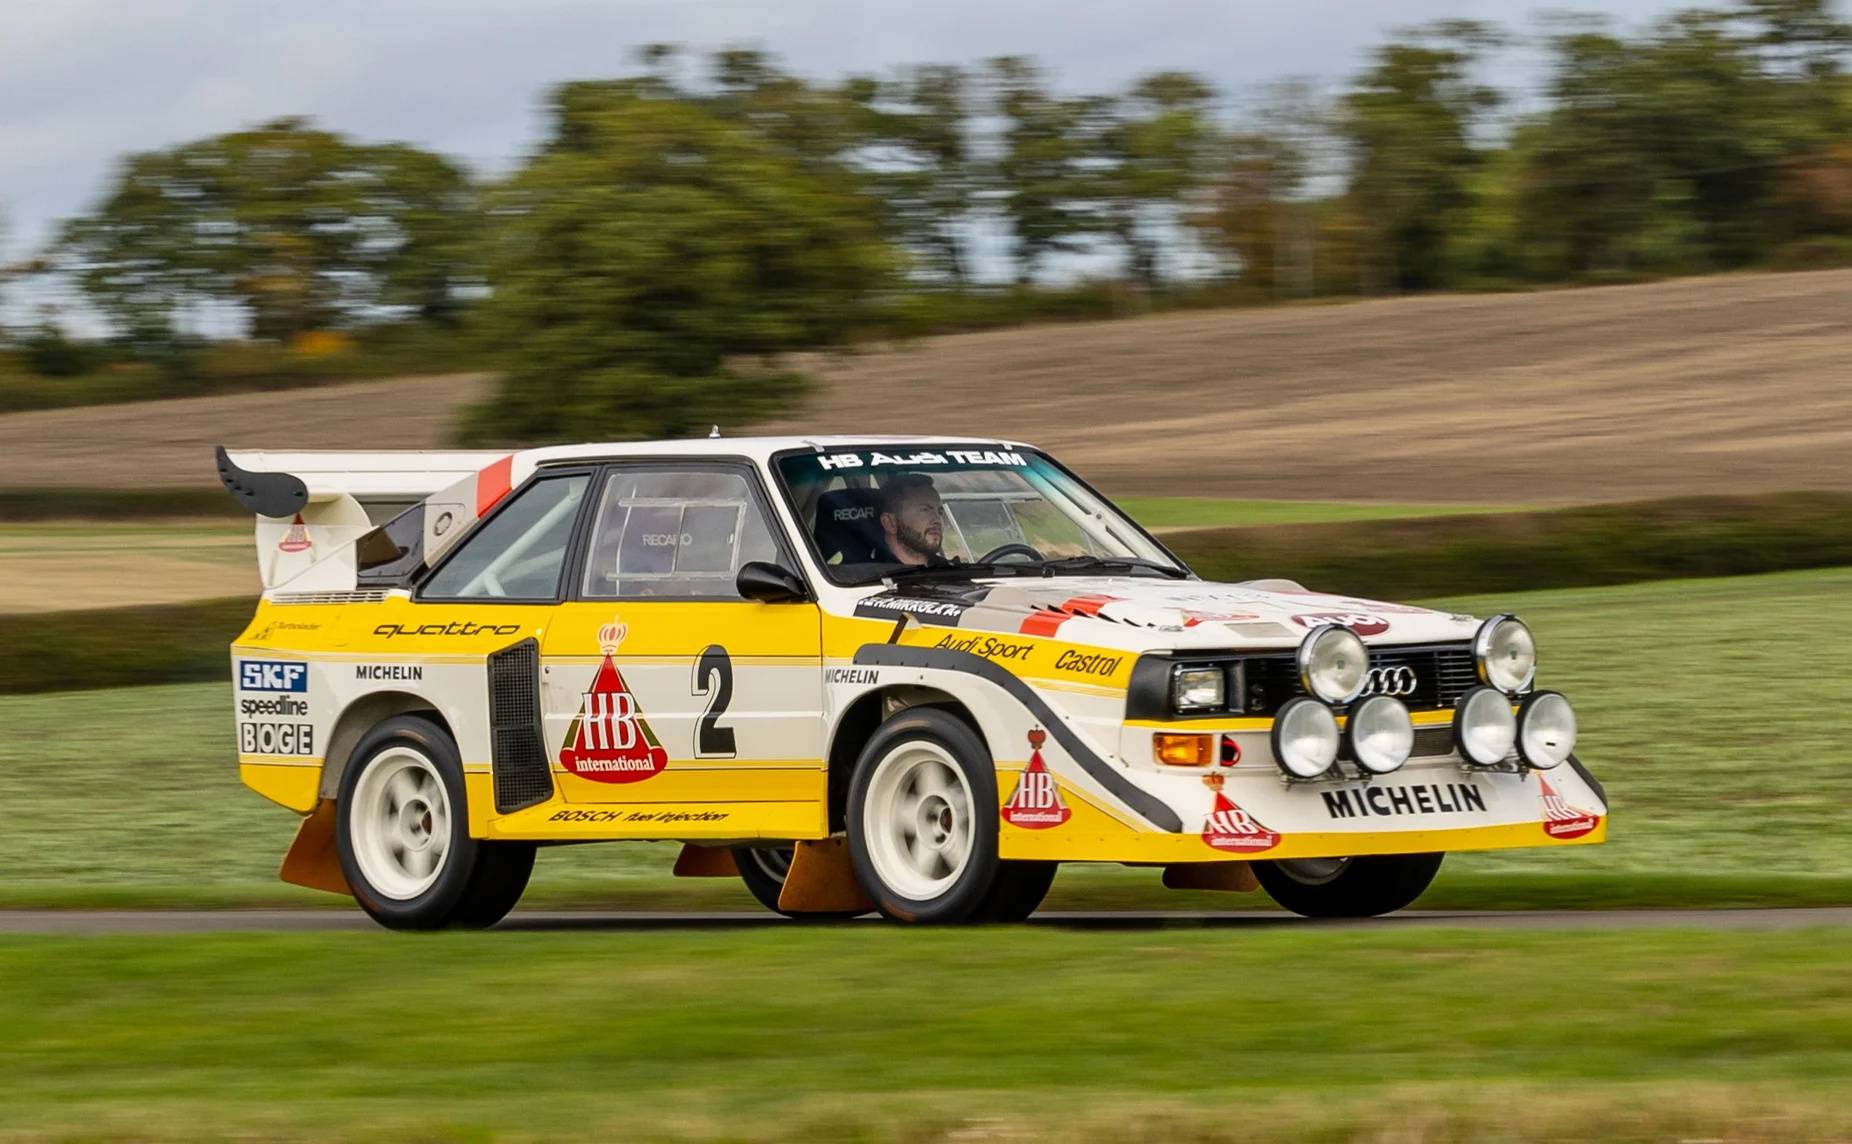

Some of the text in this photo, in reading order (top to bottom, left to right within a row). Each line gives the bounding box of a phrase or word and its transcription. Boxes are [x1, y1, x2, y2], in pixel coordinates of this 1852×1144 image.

[818, 453, 863, 470] HB
[946, 450, 1027, 466] TEAM
[373, 621, 520, 639] quattro
[934, 634, 1034, 660] Audi Sport
[356, 665, 423, 681] MICHELIN
[1055, 649, 1123, 677] Castrol
[242, 664, 304, 689] SKF
[825, 669, 879, 684] MICHELIN
[241, 695, 308, 719] speedline
[691, 644, 737, 759] 2
[582, 692, 637, 750] HB
[241, 723, 313, 755] BOGE
[575, 753, 655, 772] international
[1018, 772, 1054, 808] HB
[1320, 784, 1487, 818] MICHELIN
[548, 810, 623, 822] BOSCH
[1206, 810, 1259, 834] HB
